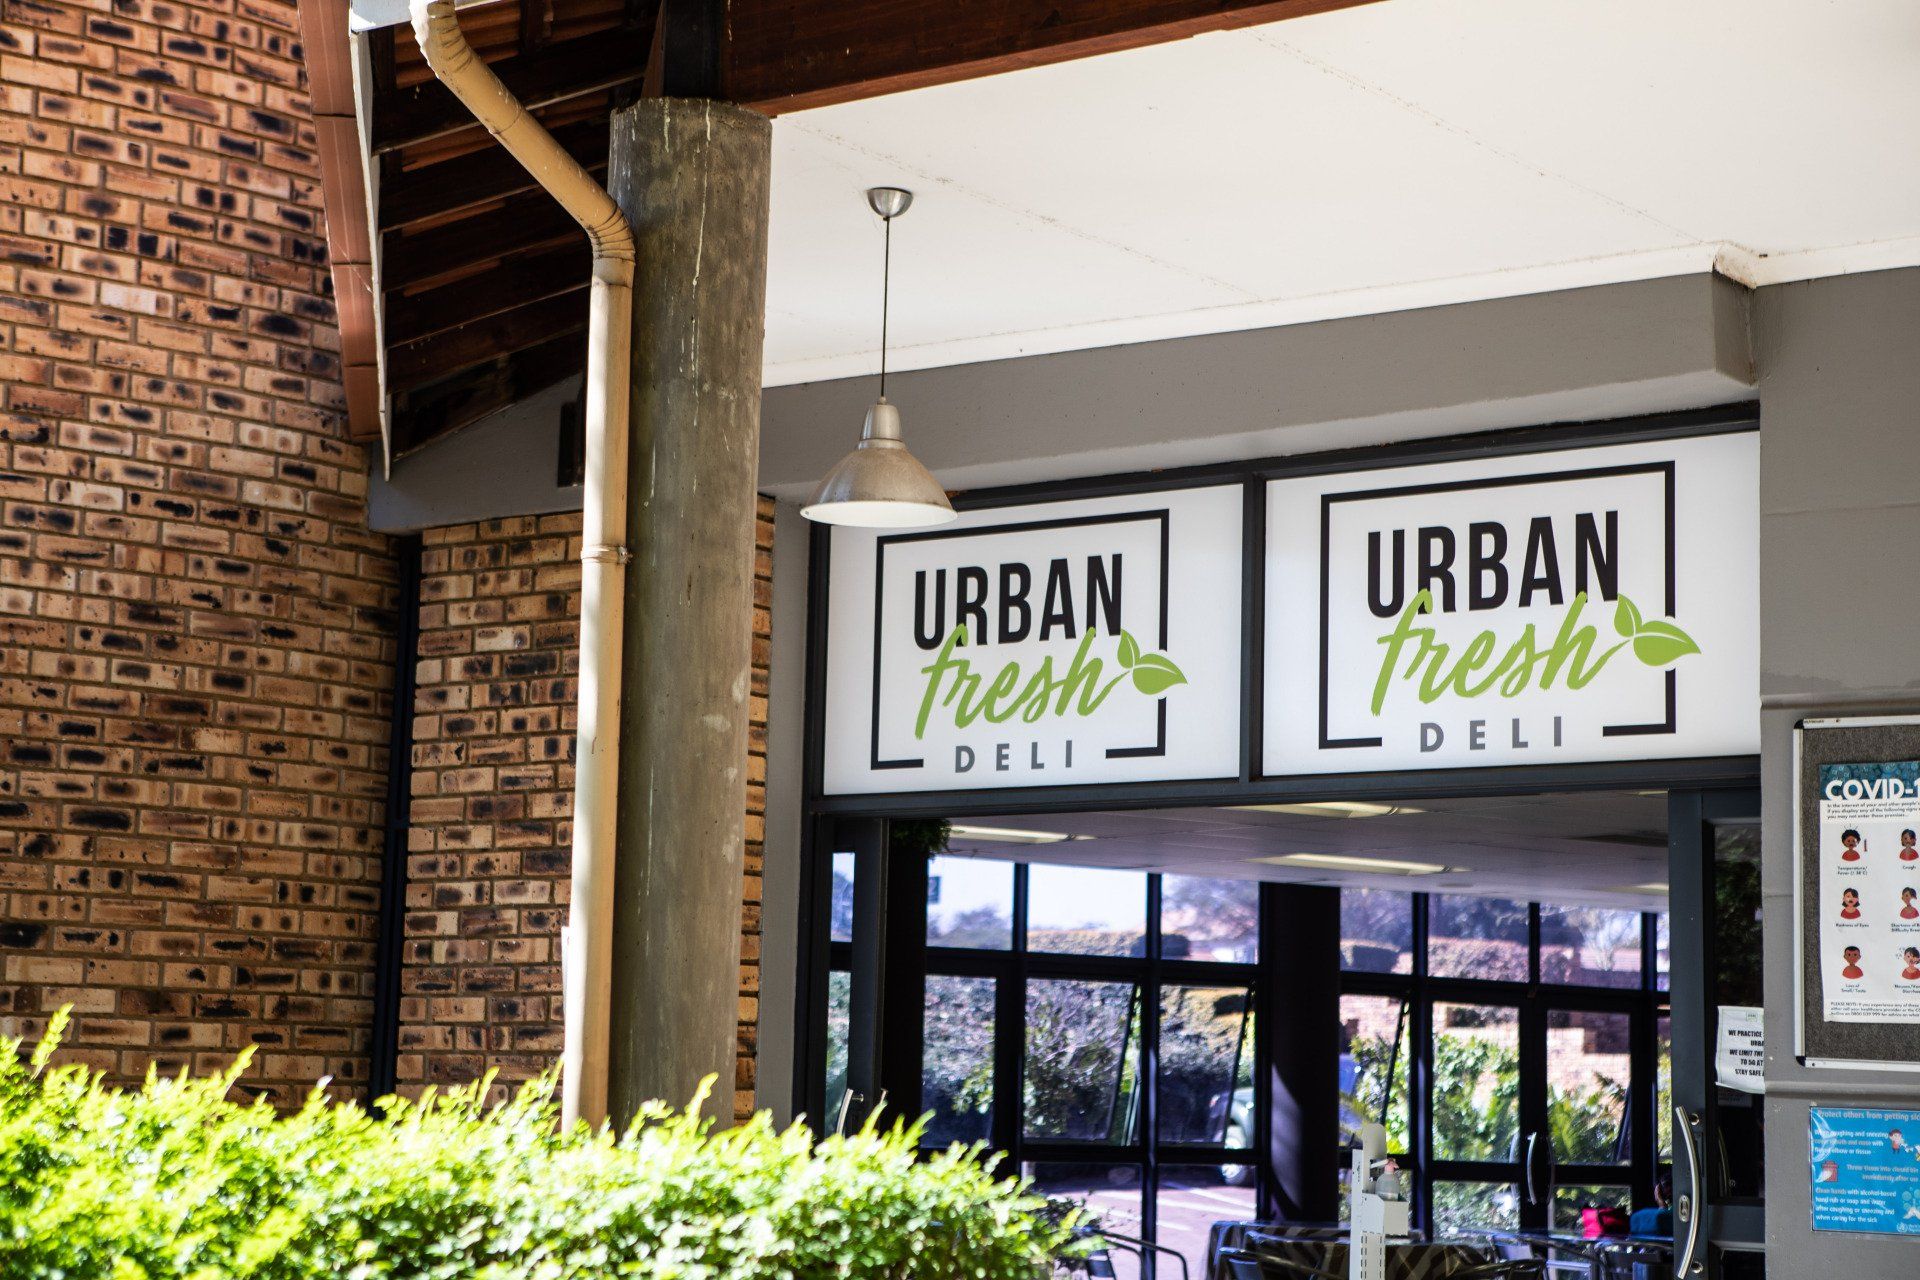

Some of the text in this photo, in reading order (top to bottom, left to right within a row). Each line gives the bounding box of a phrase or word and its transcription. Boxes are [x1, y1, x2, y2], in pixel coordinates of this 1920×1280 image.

[913, 553, 1123, 650] URBAN
[1368, 510, 1618, 619] URBAN
[914, 623, 1131, 740] fresh
[1371, 588, 1631, 717] fresh
[954, 740, 1073, 773] DELI
[1419, 716, 1562, 753] DELI
[1866, 1111, 1882, 1119] from
[1884, 1112, 1909, 1121] getting
